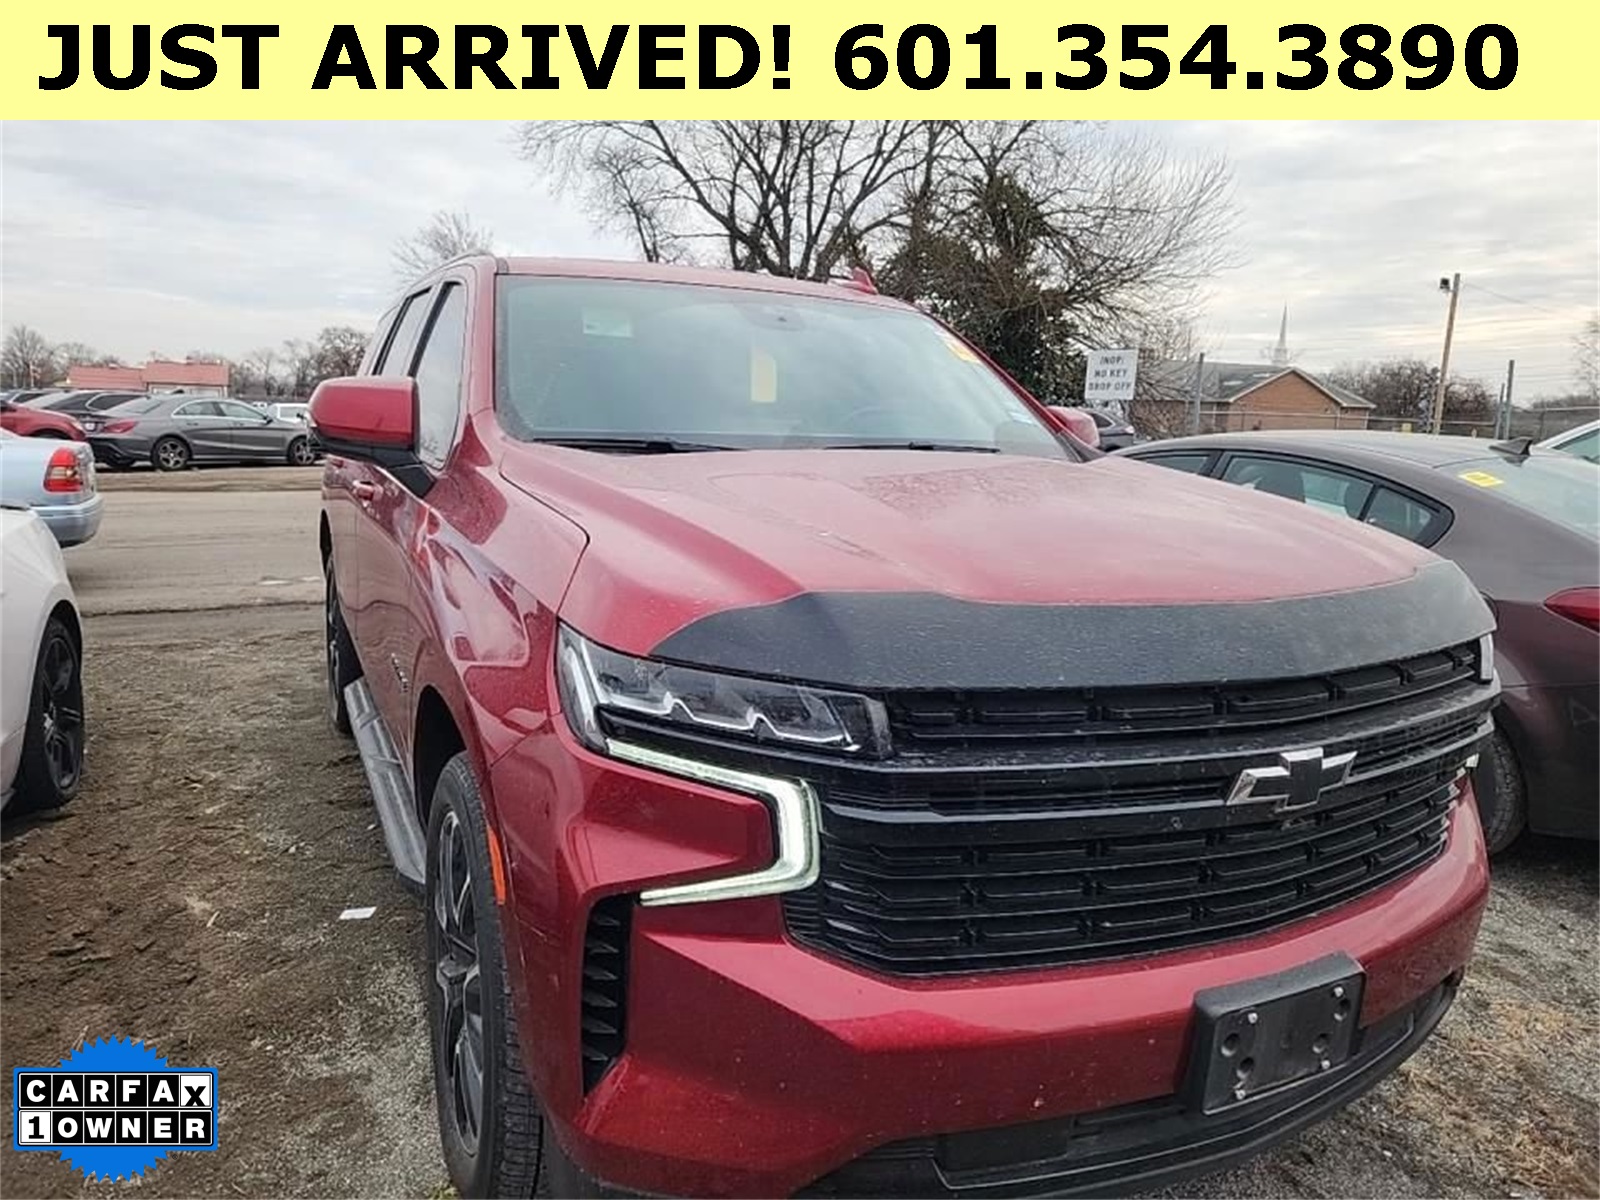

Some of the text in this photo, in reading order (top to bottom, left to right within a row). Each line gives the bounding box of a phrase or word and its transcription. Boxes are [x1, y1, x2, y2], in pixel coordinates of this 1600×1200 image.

[1109, 369, 1127, 378] KEY
[1088, 382, 1131, 391] DROP OFF
